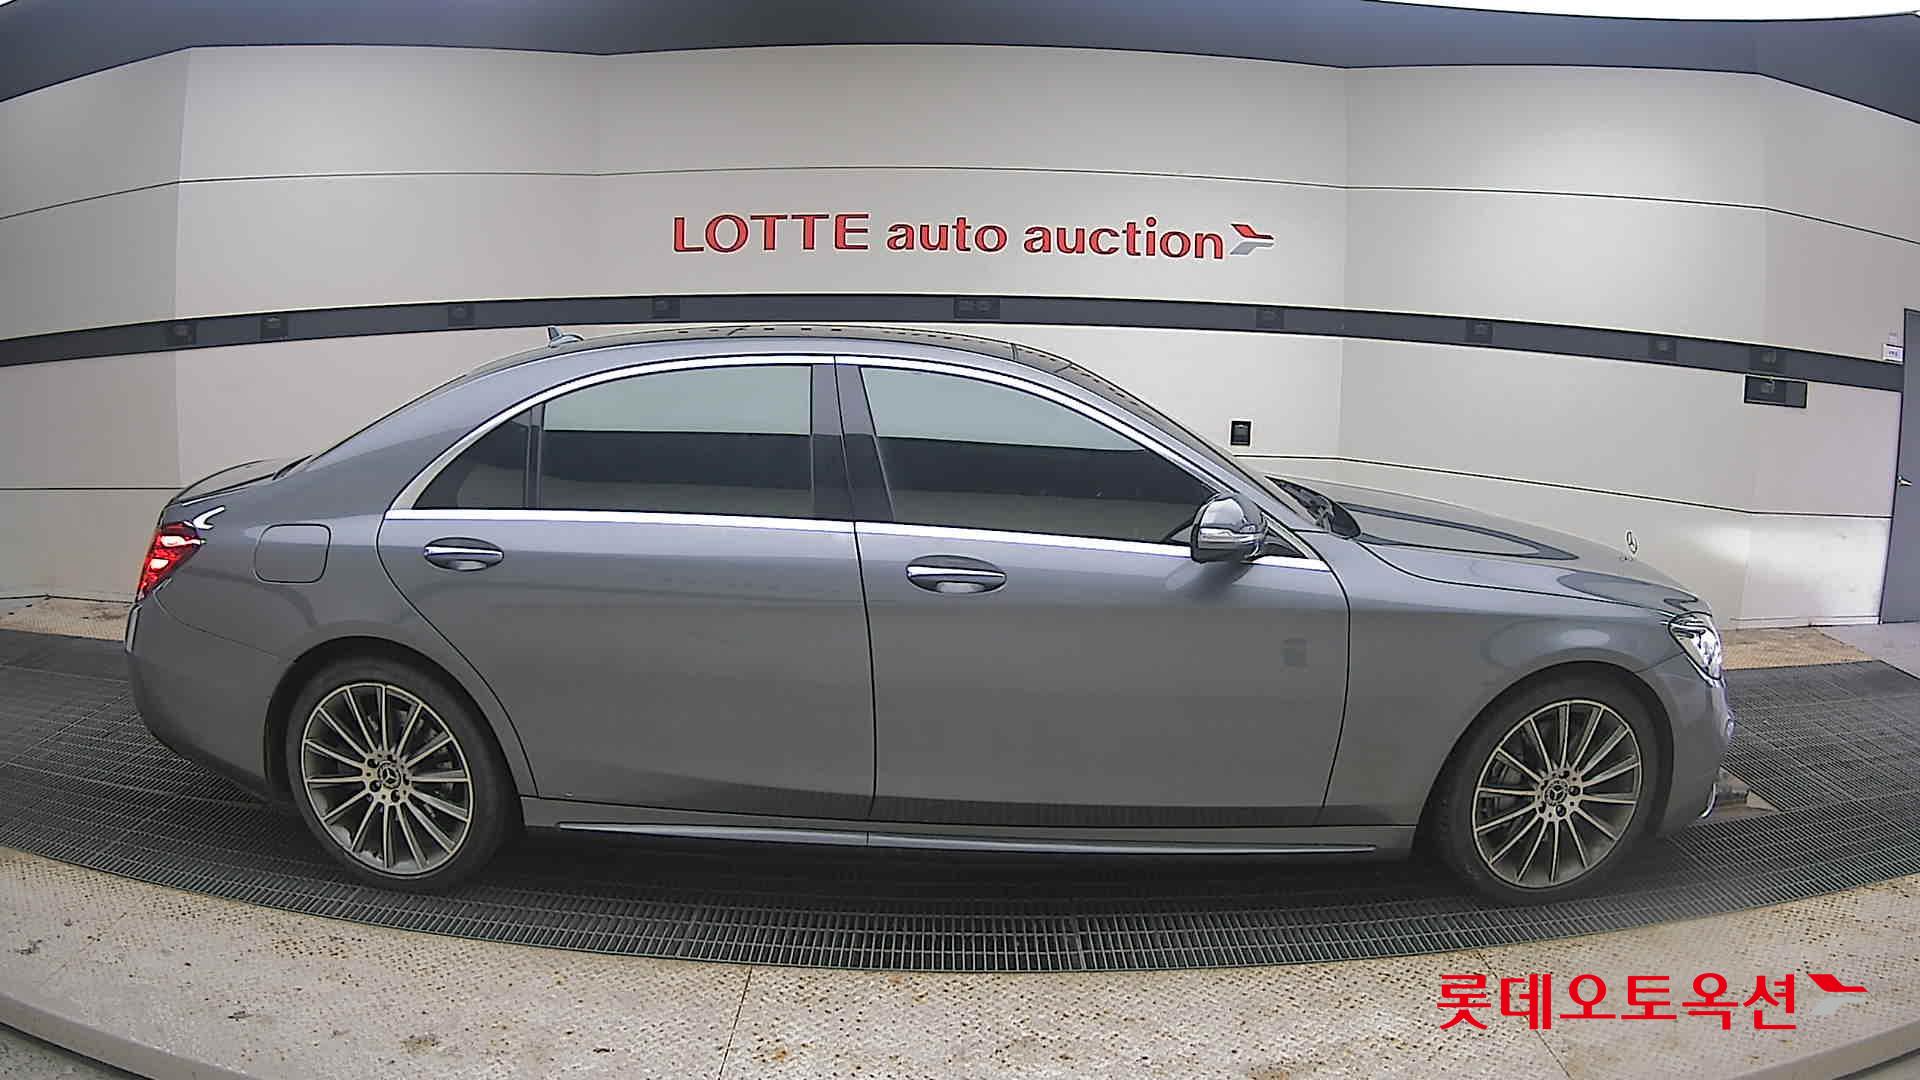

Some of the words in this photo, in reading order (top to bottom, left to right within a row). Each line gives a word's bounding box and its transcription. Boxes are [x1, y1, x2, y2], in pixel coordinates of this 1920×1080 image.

[673, 214, 869, 253] LOTTE
[887, 217, 1008, 252] auto
[1024, 217, 1224, 259] auction
